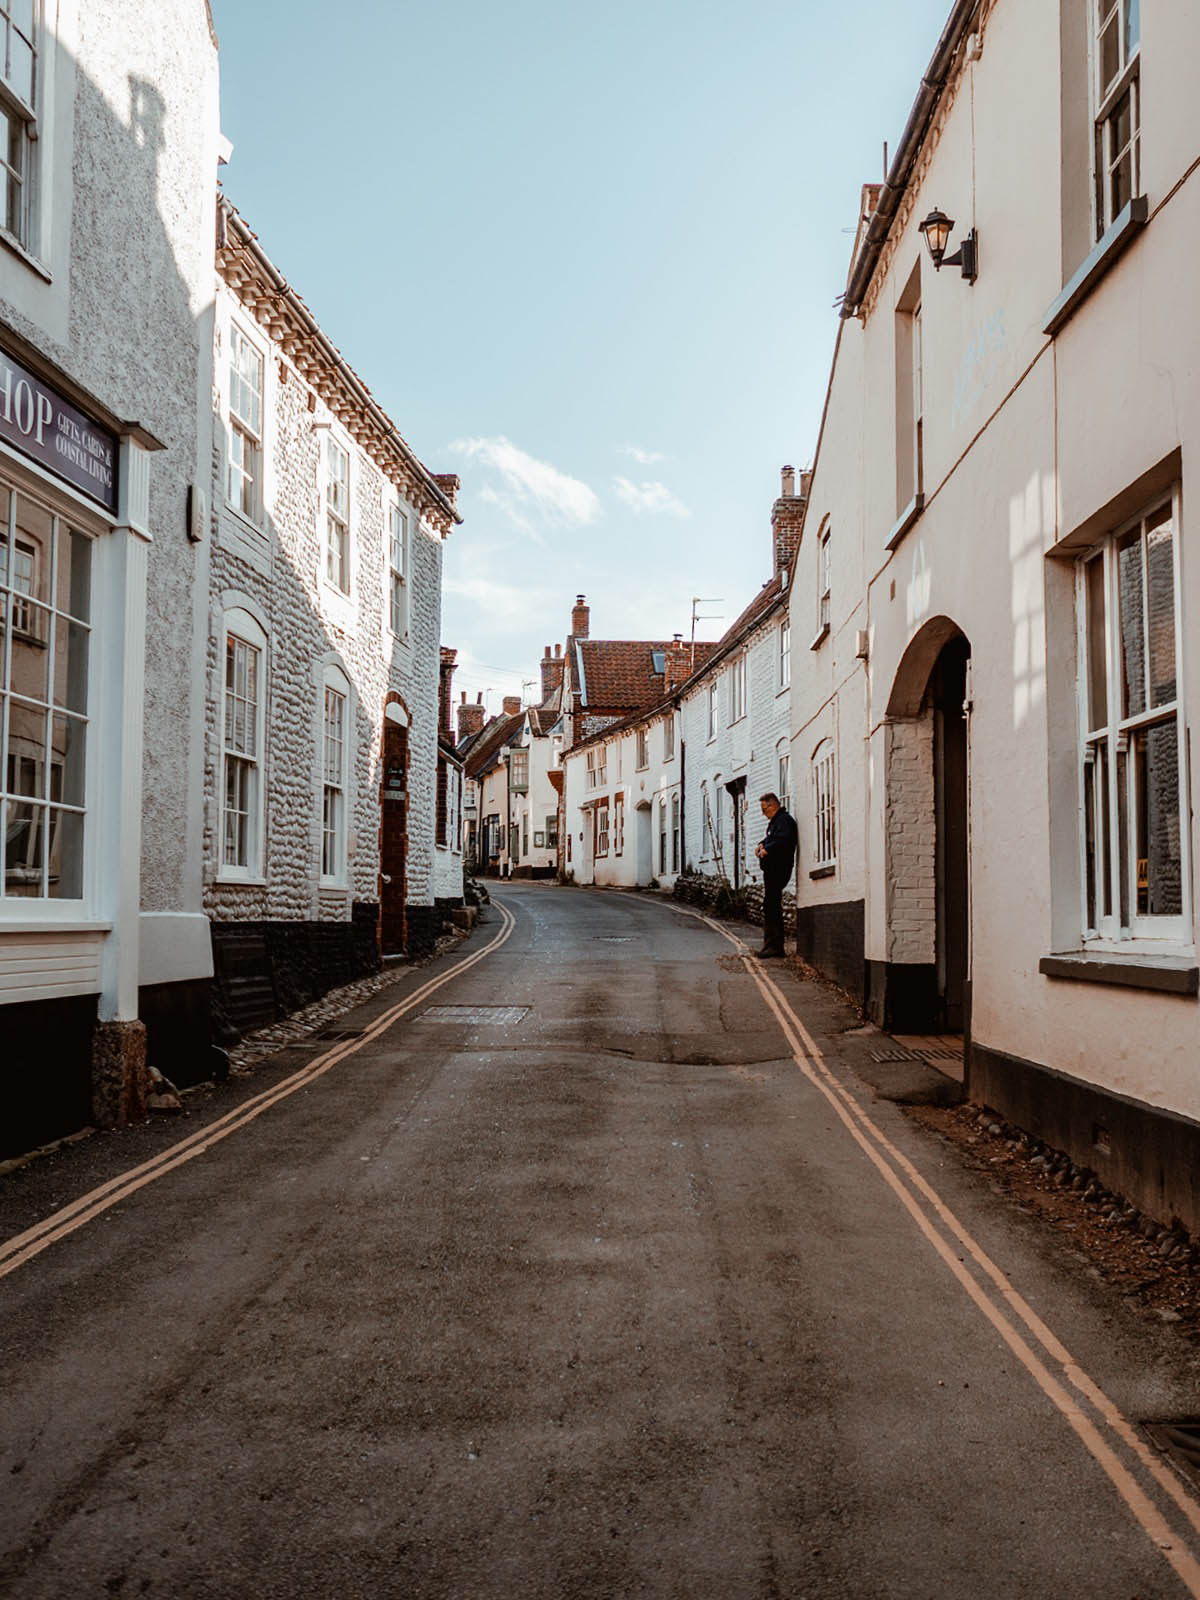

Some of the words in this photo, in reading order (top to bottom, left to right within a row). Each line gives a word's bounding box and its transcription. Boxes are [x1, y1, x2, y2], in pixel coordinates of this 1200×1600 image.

[55, 434, 88, 472] COASTAL
[88, 456, 112, 488] LIVING
[106, 449, 112, 467] &
